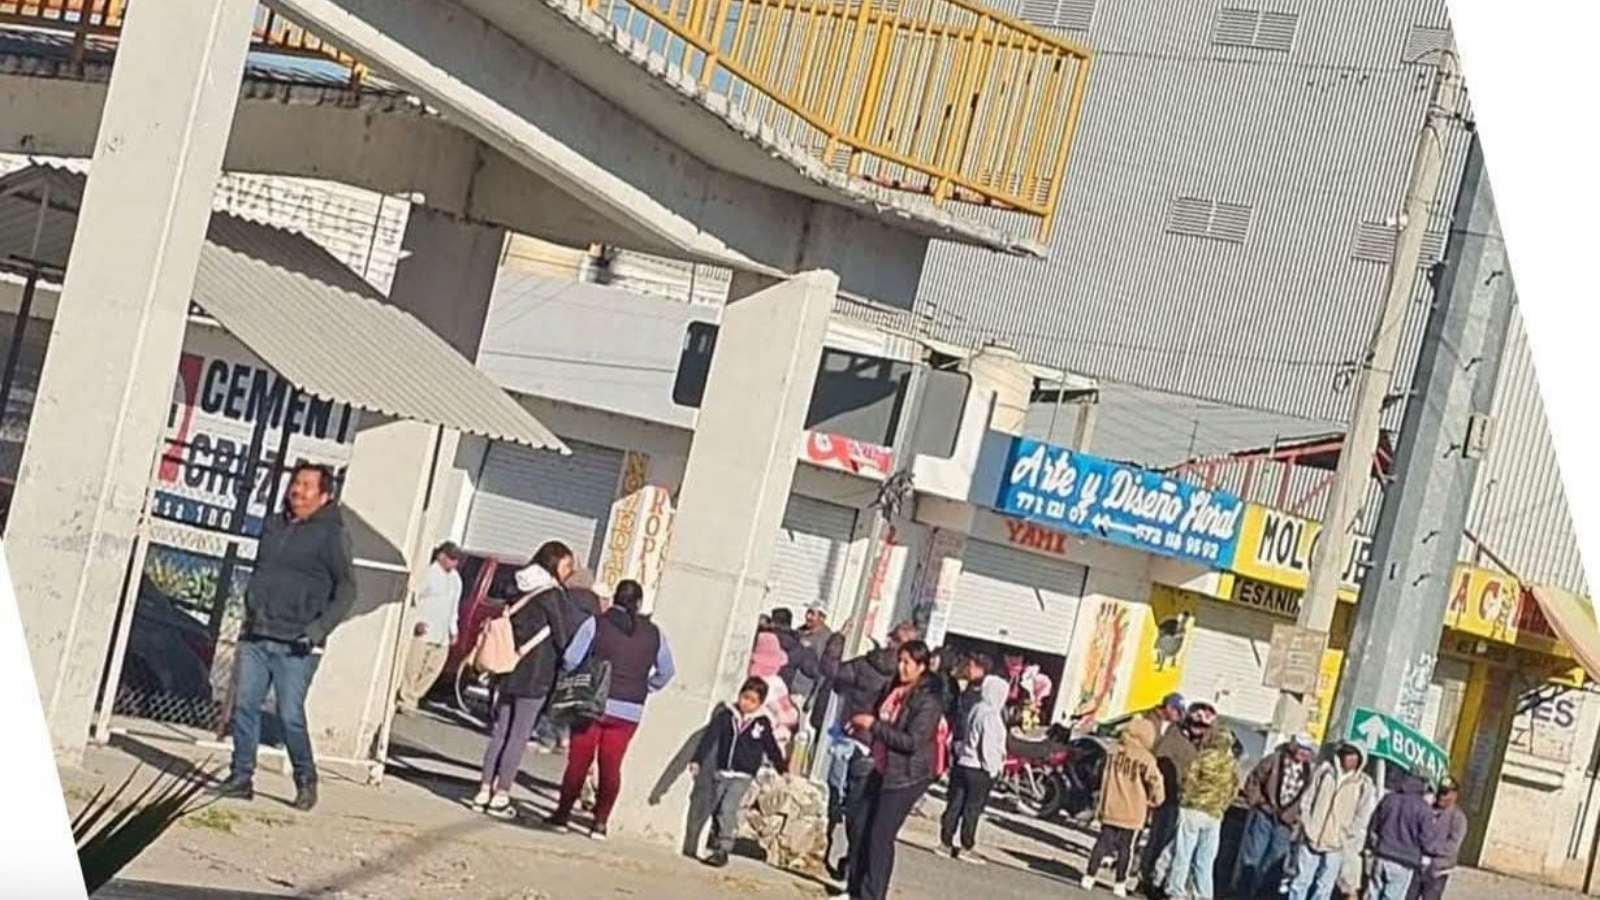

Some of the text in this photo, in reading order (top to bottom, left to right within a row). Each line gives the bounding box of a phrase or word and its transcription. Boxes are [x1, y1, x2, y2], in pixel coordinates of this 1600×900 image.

[1010, 445, 1243, 540] Arte y Diseño Floral
